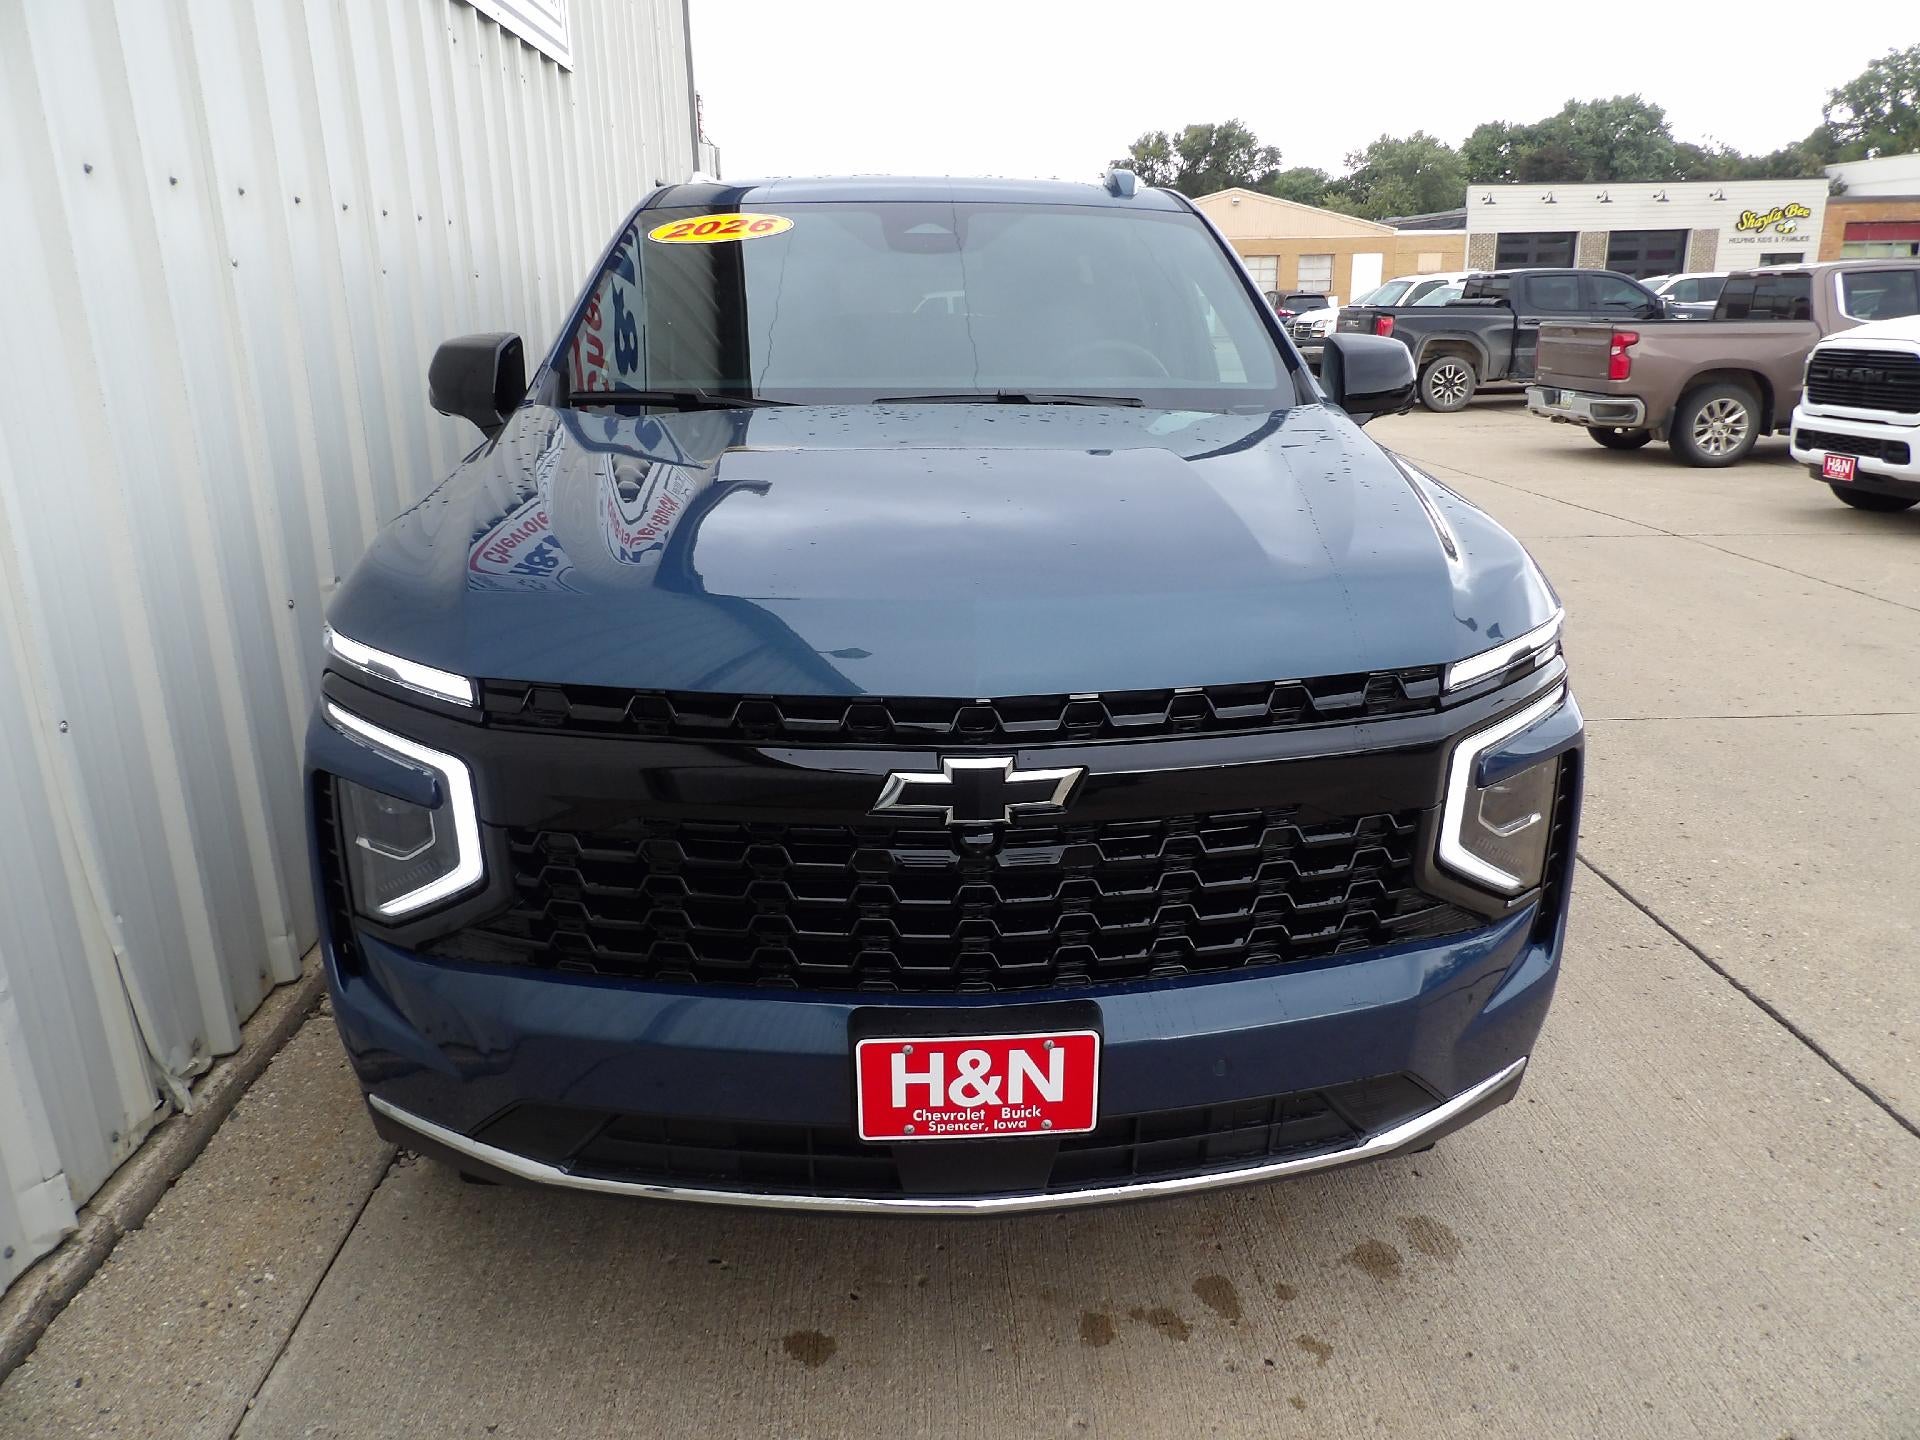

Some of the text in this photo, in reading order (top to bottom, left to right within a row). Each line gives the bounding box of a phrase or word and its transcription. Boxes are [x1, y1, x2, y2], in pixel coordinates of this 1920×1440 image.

[1737, 203, 1811, 233] Shayla Bee
[663, 218, 778, 239] 2026
[1728, 236, 1756, 244] HELPING
[1781, 235, 1810, 243] FAMILIES
[1832, 367, 1884, 383] RAM
[1826, 457, 1851, 474] H&N
[890, 1047, 1066, 1109] H&N
[912, 1104, 1041, 1122] Chevrolet Buick
[928, 1119, 1027, 1133] Spencer, Iowa
